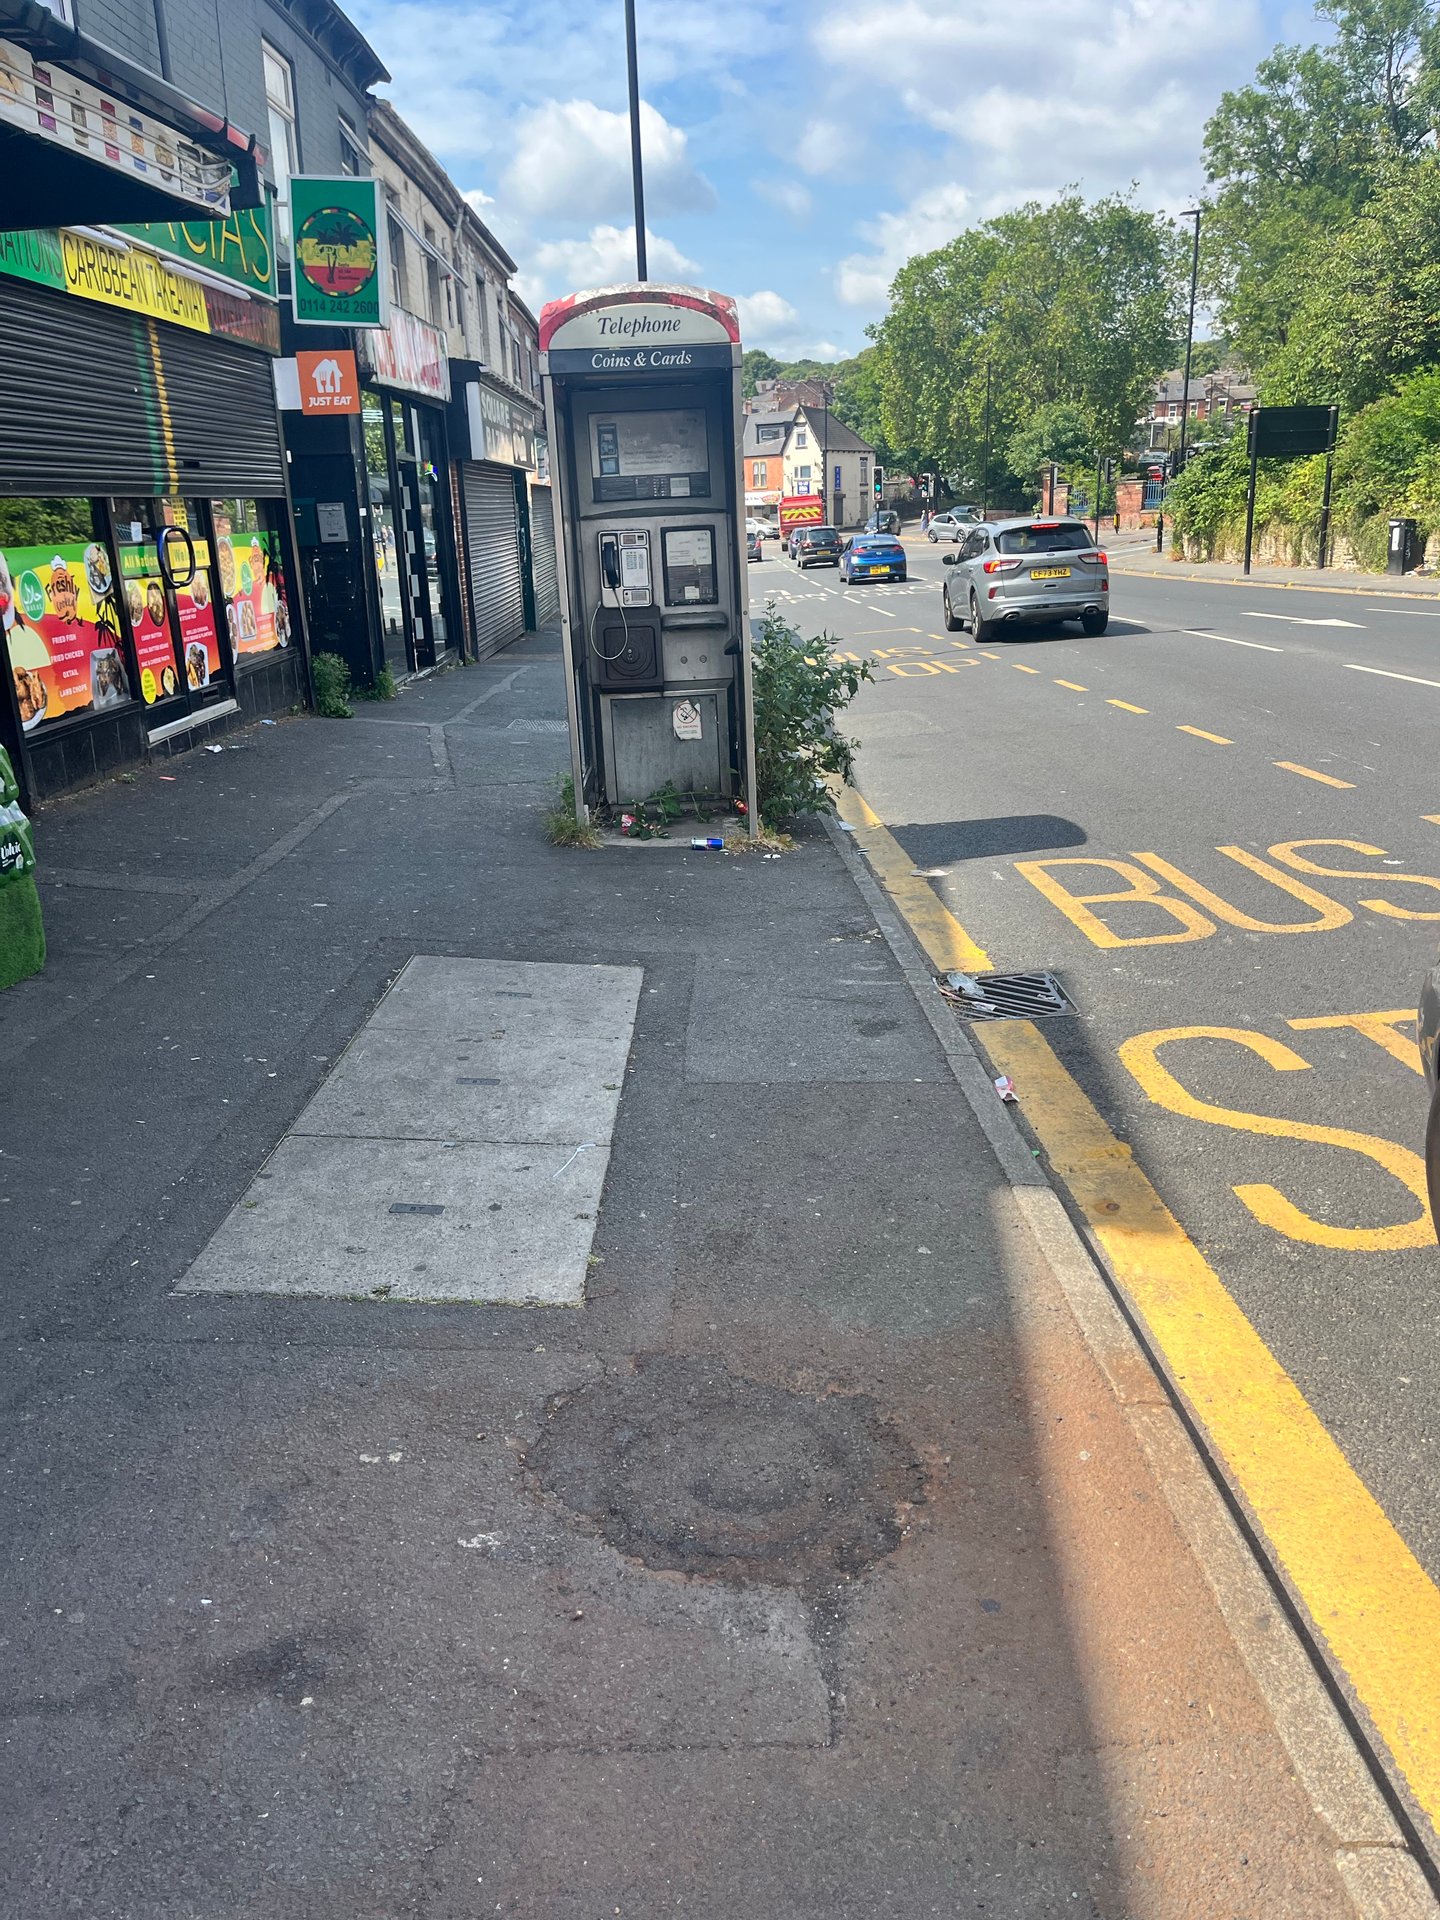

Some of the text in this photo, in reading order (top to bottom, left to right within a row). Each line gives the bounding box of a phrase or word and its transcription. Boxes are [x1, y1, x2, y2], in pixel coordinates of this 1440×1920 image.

[64, 233, 149, 305] CARIBBEAN
[146, 262, 205, 324] TAKEAWAY
[300, 299, 379, 315] 0114 242 2600
[597, 316, 681, 337] Telephone
[592, 351, 692, 369] Coins & Cards
[308, 396, 352, 408] JUST EAT
[481, 391, 510, 429] SQUARE
[124, 555, 135, 569] All
[174, 548, 206, 562] Welme
[45, 574, 80, 602] Freshly
[52, 633, 76, 645] FRIED FISH
[64, 650, 84, 660] CHICKEN
[62, 669, 79, 678] OXTAIL
[887, 658, 982, 677] OP
[1013, 839, 1440, 948] BUS
[1117, 1009, 1440, 1251] ST
